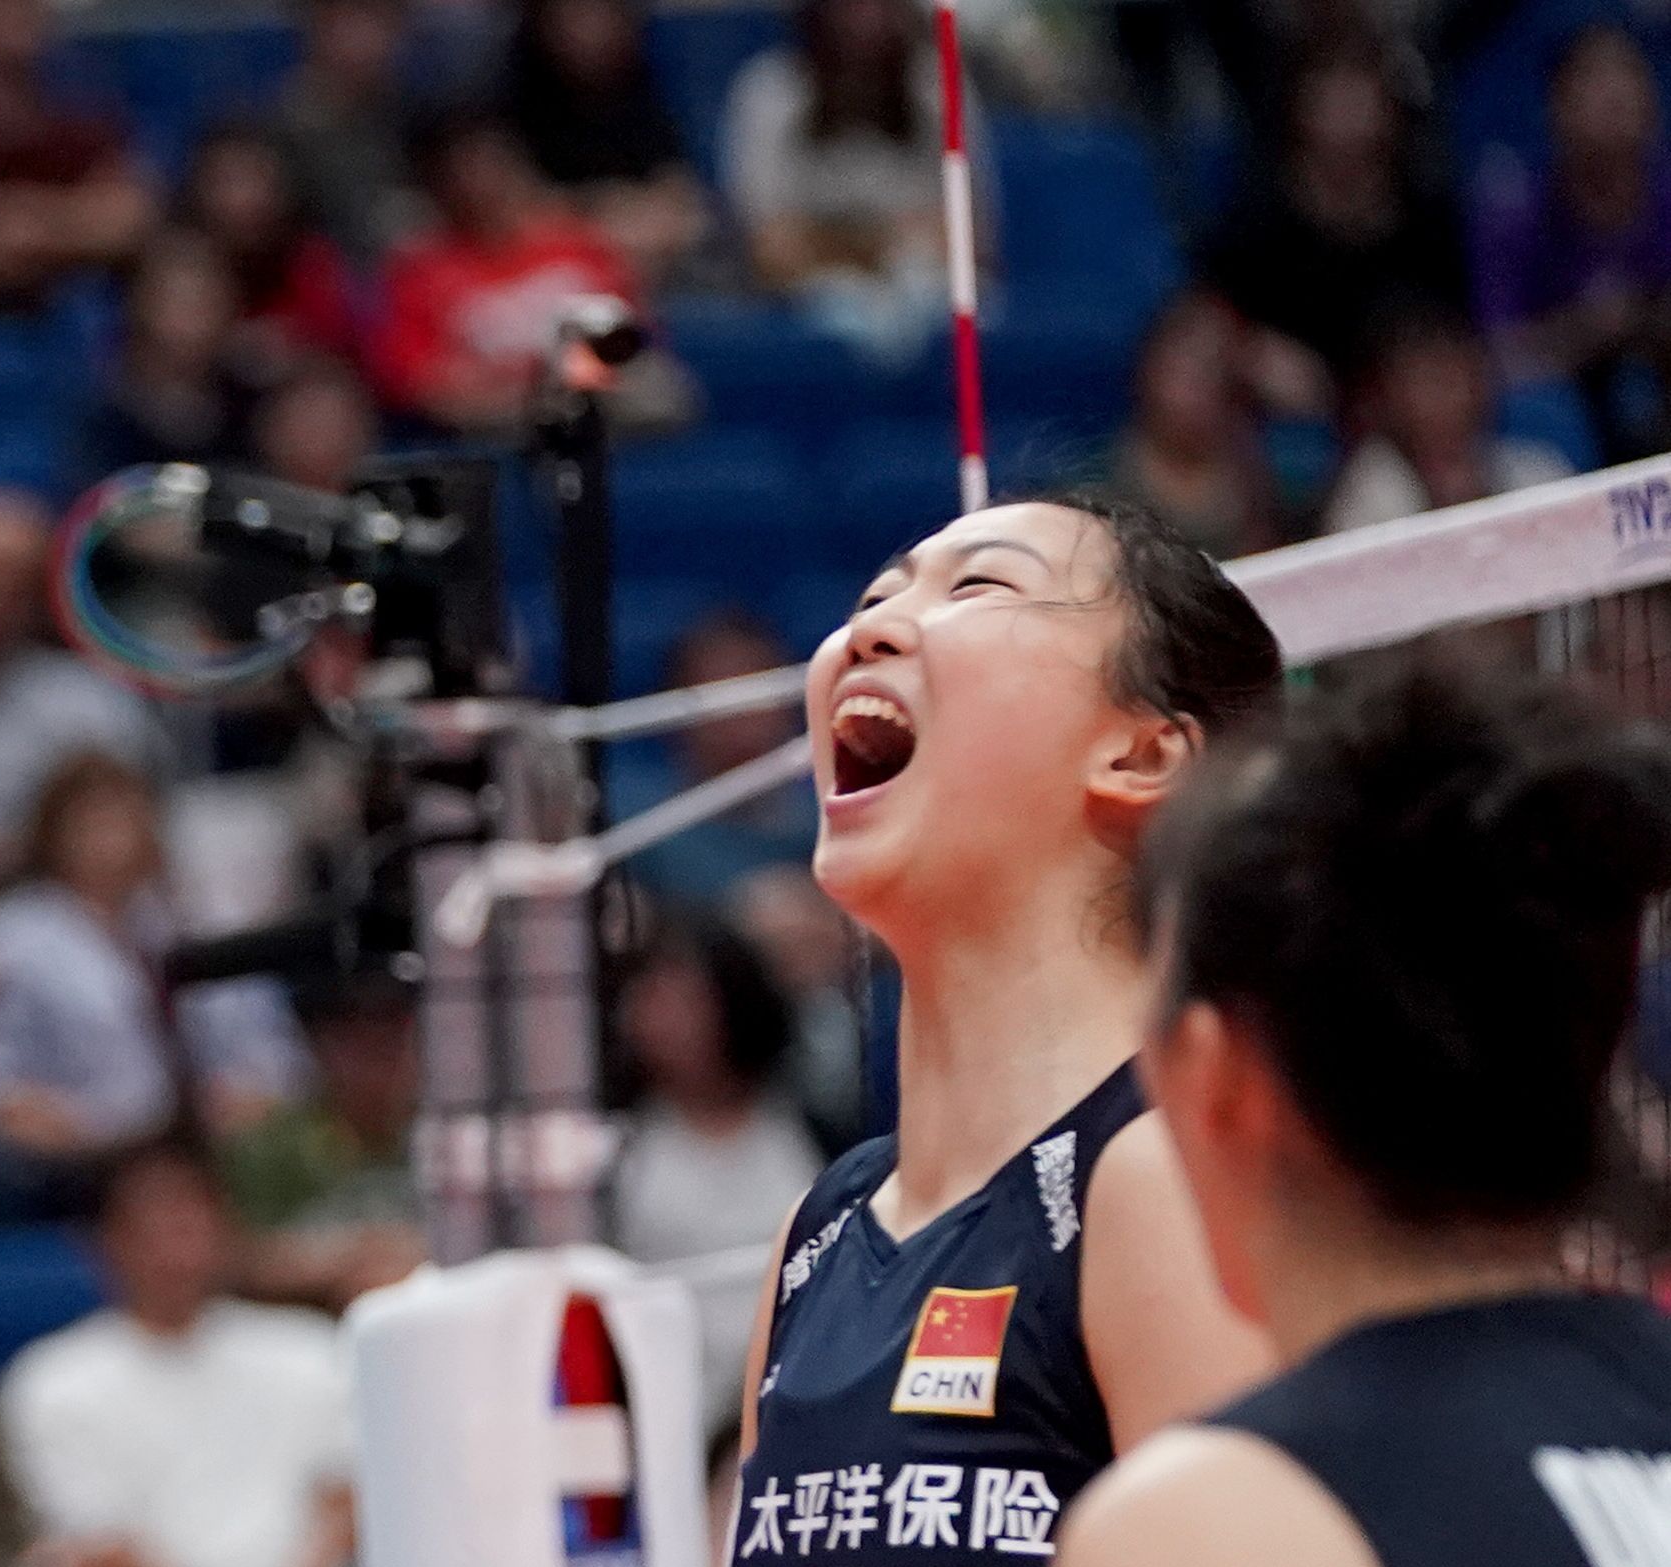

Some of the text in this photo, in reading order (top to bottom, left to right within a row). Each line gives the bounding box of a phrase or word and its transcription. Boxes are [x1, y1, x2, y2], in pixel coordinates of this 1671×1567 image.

[909, 1371, 985, 1400] CHN
[740, 1463, 1060, 1556] 太平洋保险
